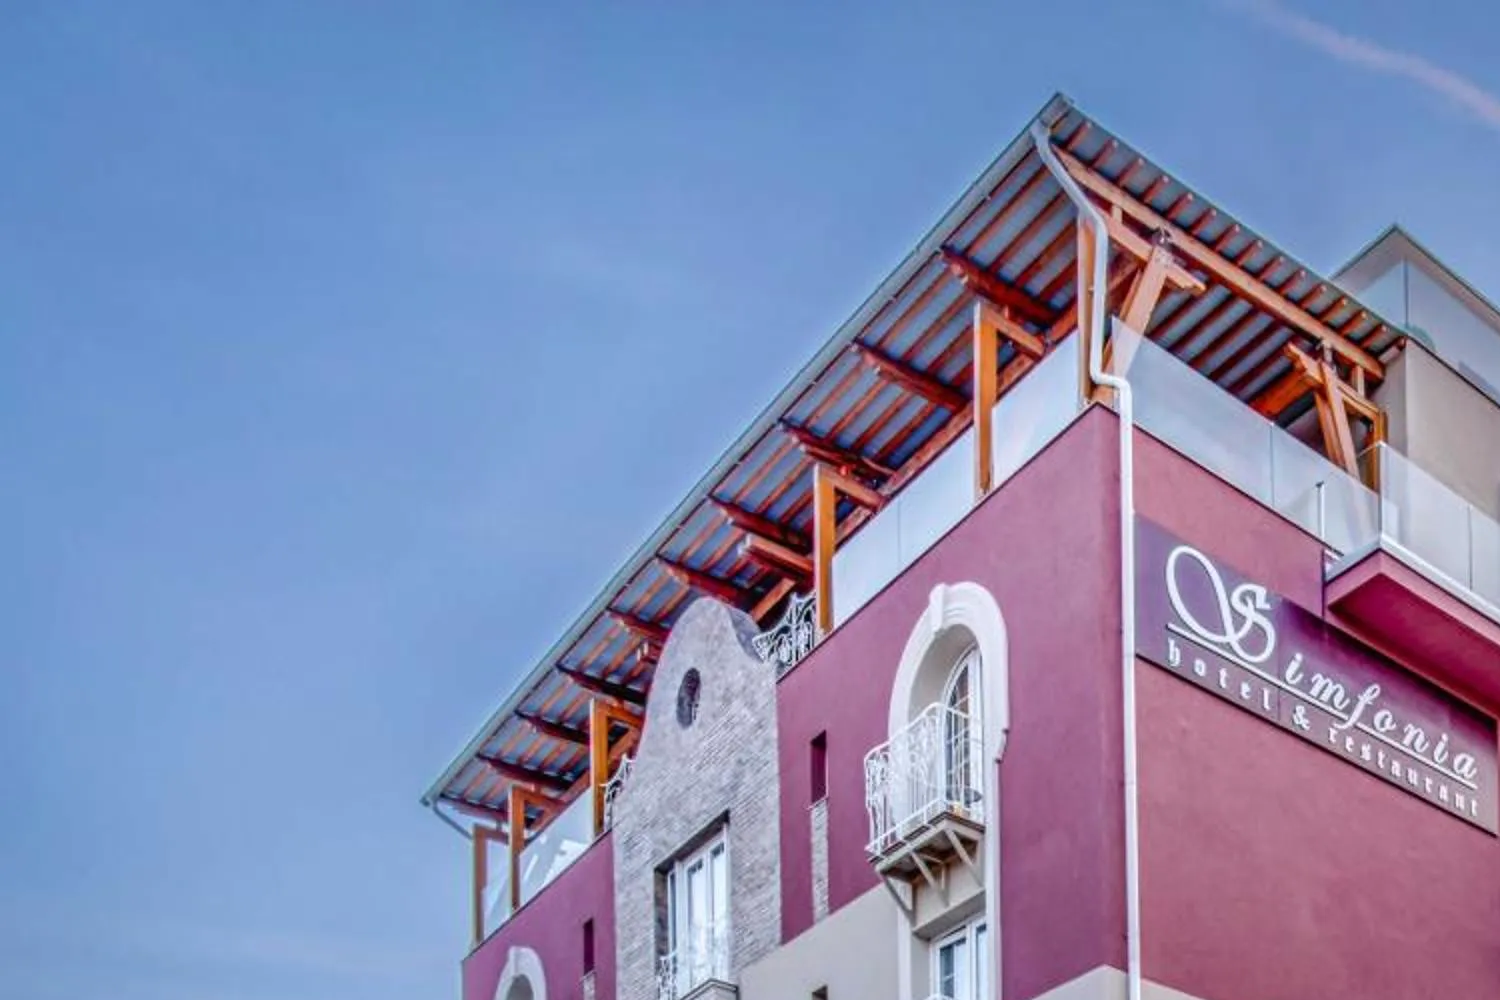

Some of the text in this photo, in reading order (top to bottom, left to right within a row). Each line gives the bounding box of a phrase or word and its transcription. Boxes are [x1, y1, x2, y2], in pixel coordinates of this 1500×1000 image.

[1166, 545, 1478, 780] Simfonia
[1167, 640, 1478, 817] hotel & restaurant
